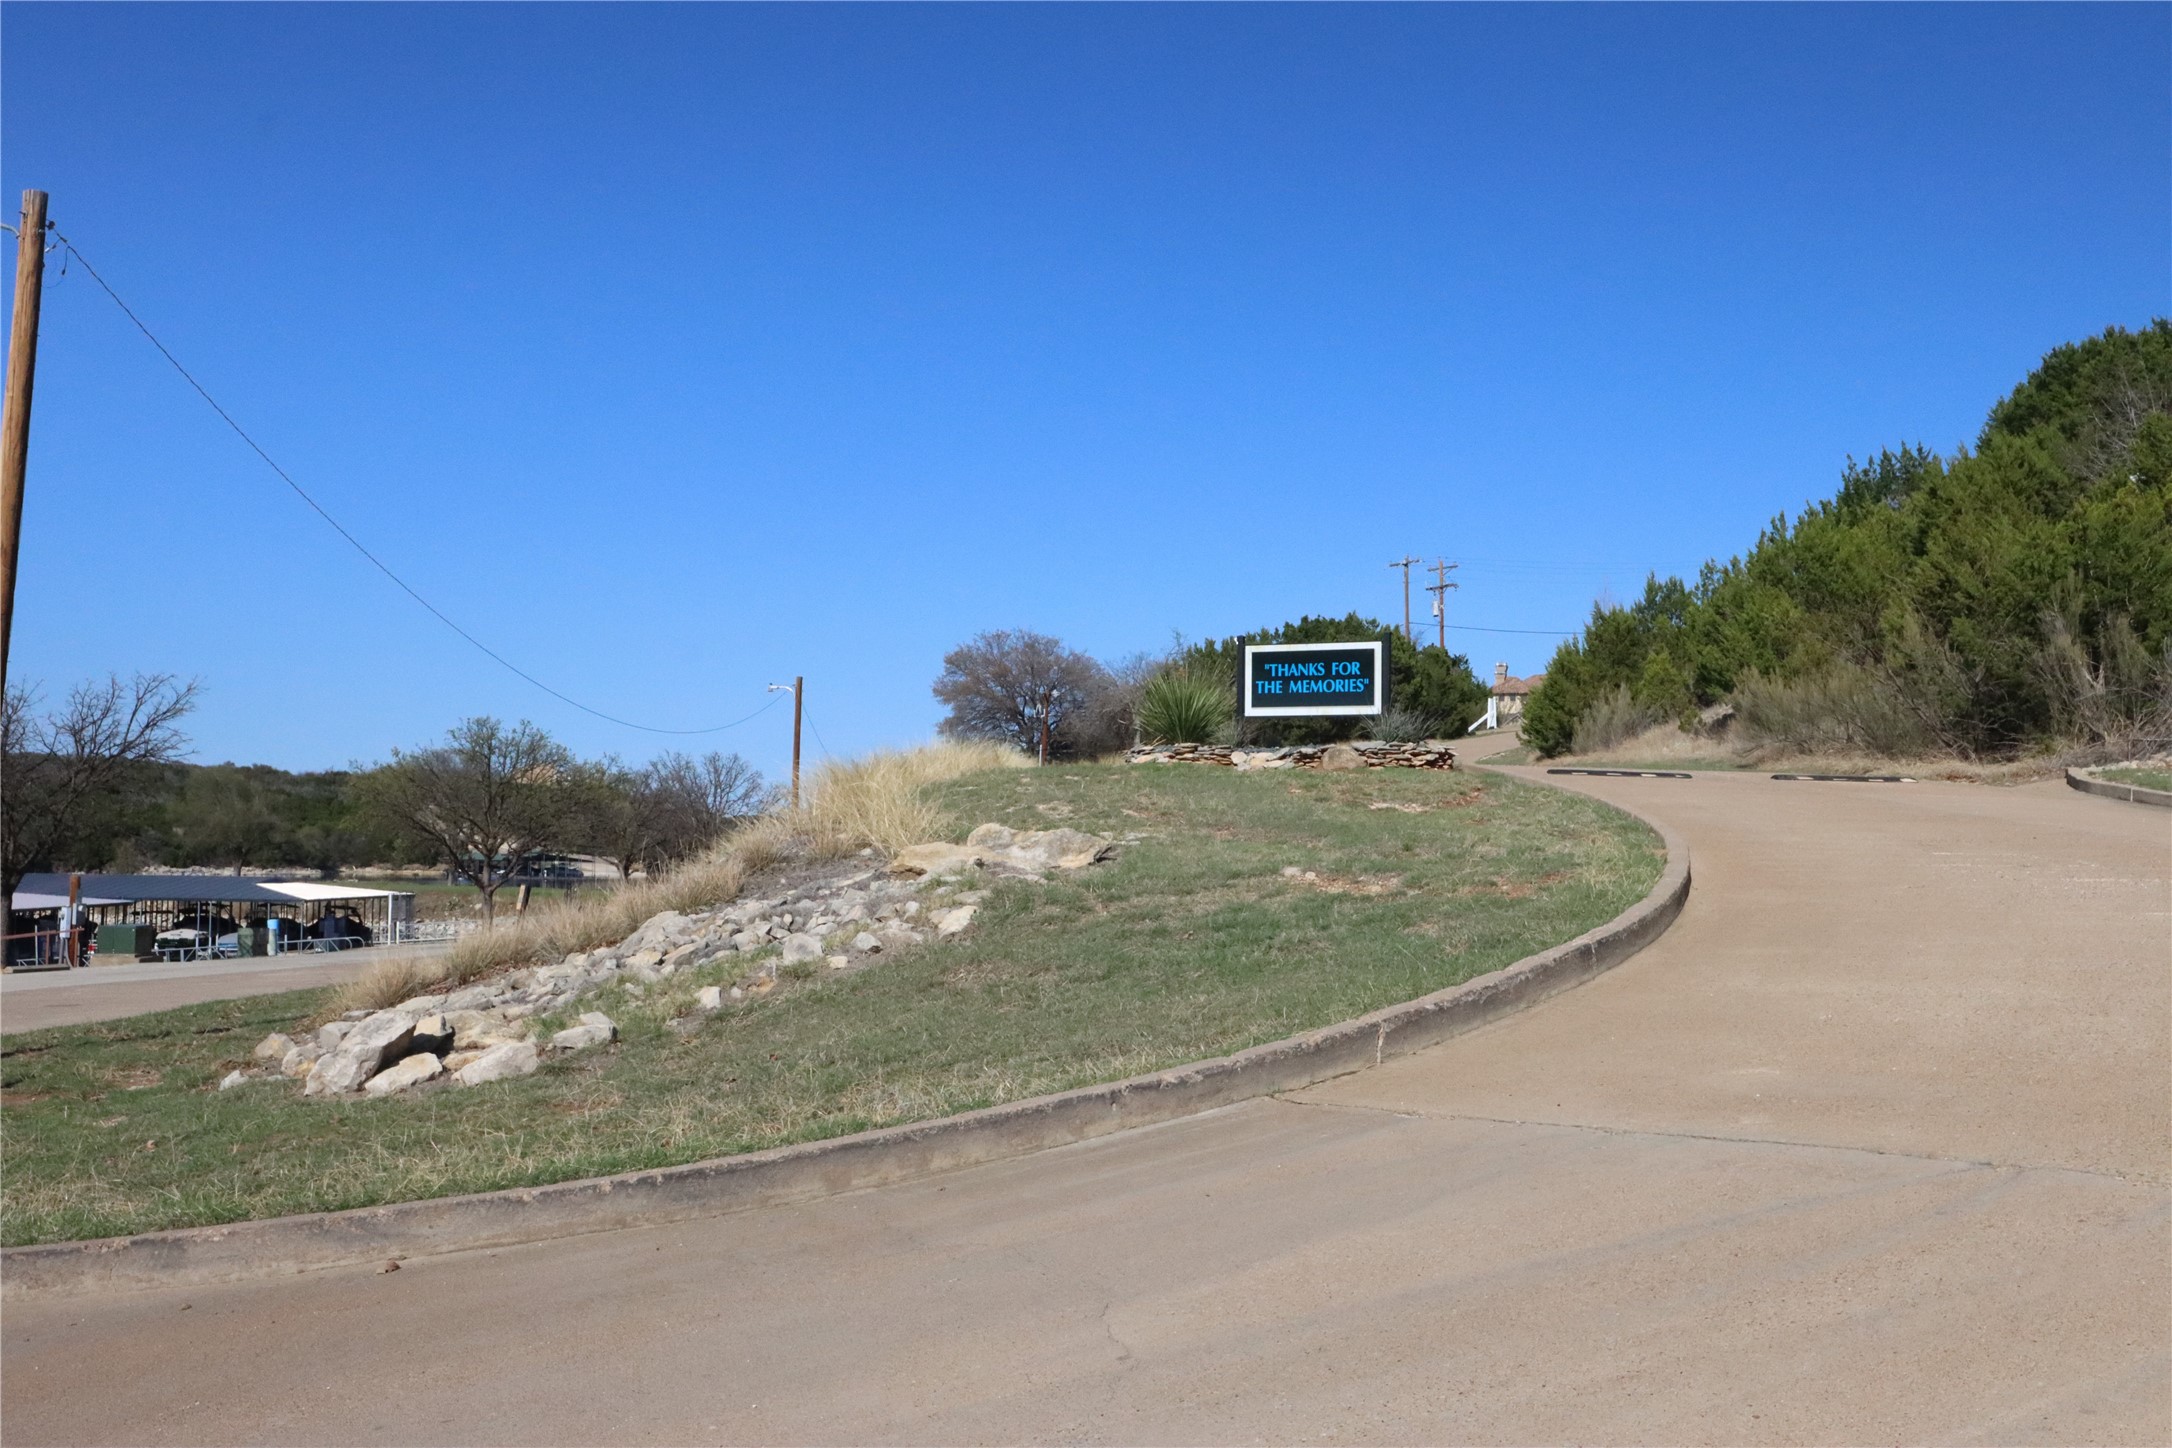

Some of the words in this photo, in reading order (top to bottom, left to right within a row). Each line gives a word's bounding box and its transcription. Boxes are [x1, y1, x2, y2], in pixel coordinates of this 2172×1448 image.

[1264, 662, 1325, 677] "THANKS
[1331, 661, 1361, 676] FOR
[1255, 680, 1283, 694] THE
[1289, 678, 1369, 693] MEMORIES"
